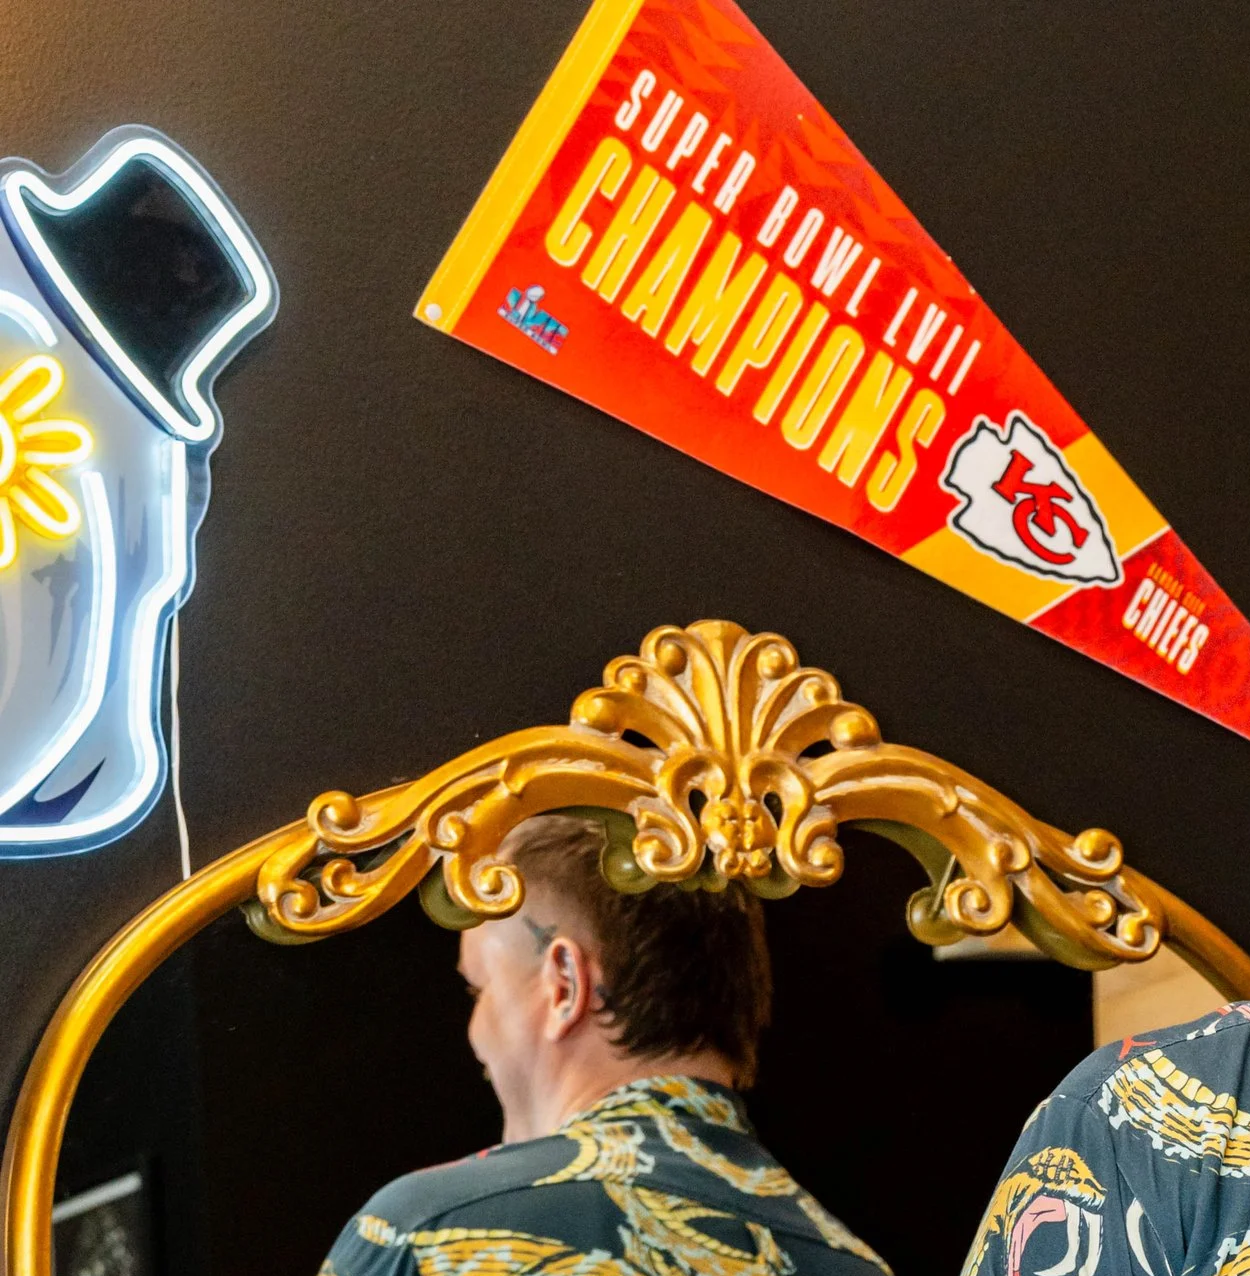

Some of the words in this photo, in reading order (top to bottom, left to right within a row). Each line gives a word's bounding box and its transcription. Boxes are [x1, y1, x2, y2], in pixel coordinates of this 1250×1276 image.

[544, 136, 947, 513] CHAMPIONS
[614, 69, 756, 214] SUPER
[756, 185, 882, 318] BOWL
[882, 287, 982, 396] LVII
[991, 449, 1090, 566] KC
[1121, 577, 1211, 676] CHIEFS
